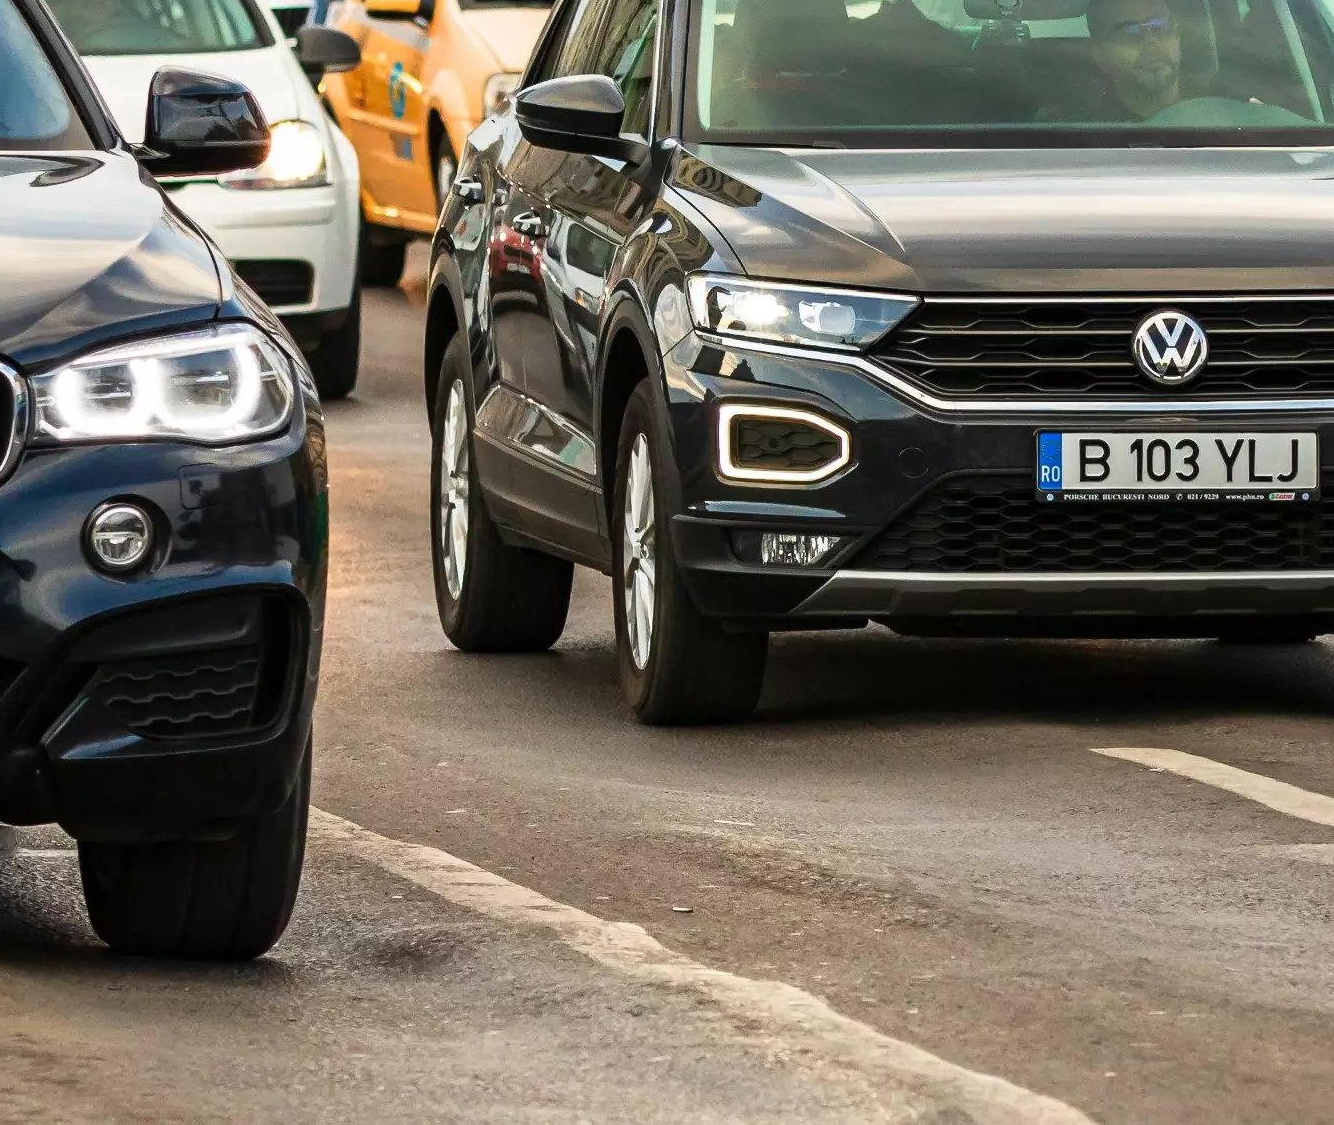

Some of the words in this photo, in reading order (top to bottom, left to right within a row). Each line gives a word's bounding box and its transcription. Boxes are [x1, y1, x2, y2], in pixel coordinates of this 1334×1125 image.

[1079, 438, 1111, 483] B
[1130, 438, 1200, 483] 103
[1214, 438, 1299, 483] YLJ
[1042, 465, 1060, 482] RO
[1063, 493, 1099, 501] PORSCHE
[1102, 493, 1145, 501] BUCURESTI
[1147, 493, 1170, 501] NORD
